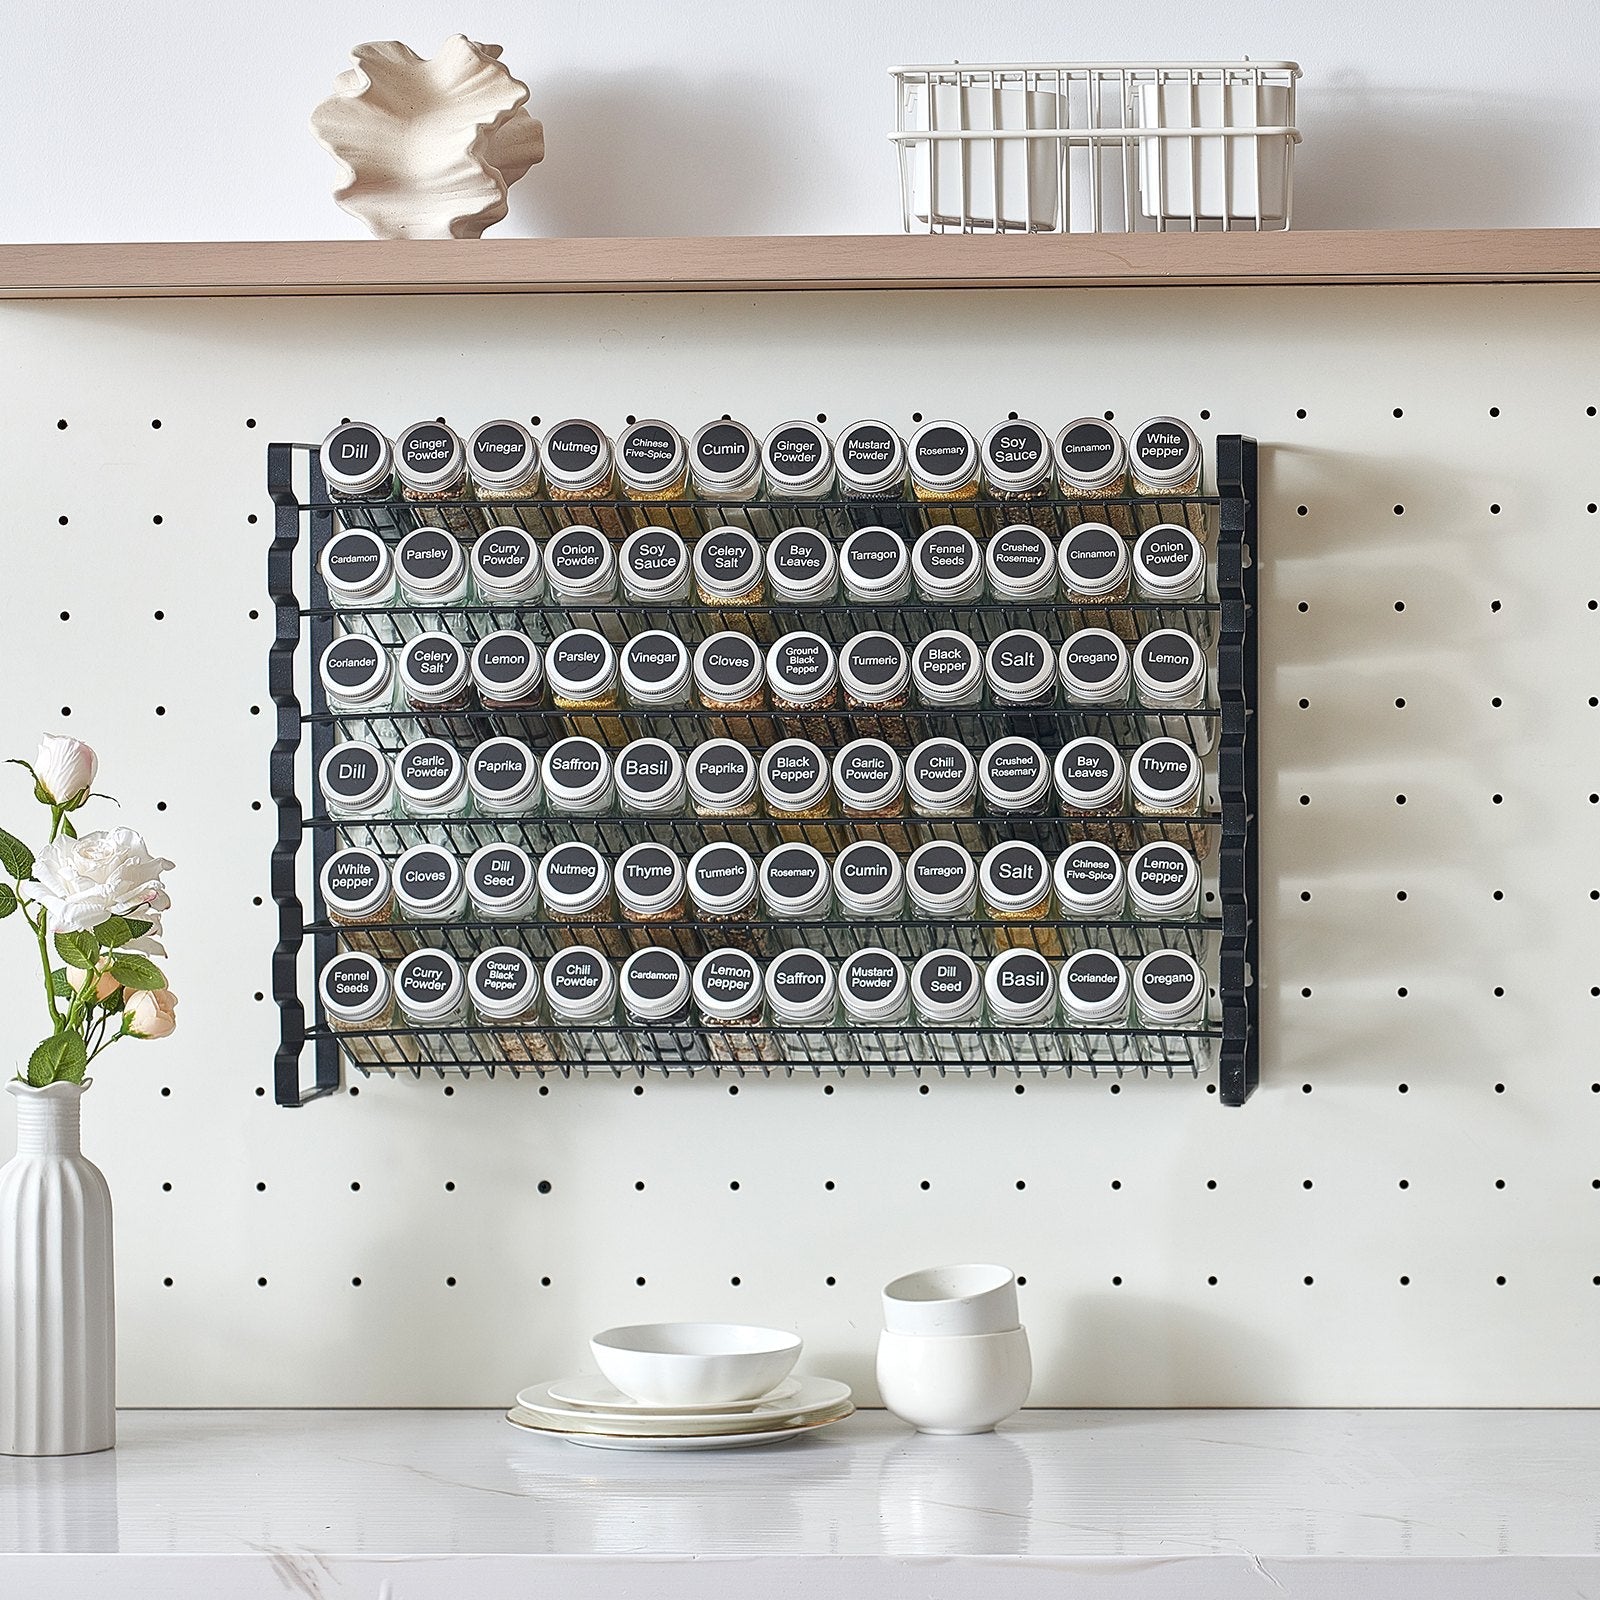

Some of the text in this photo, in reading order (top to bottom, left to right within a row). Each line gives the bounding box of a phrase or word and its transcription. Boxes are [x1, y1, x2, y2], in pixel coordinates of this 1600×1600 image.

[409, 439, 448, 451] Ginger
[632, 437, 669, 449] Chinese
[848, 439, 891, 450] Mustard
[1000, 436, 1027, 450] Soy
[1146, 433, 1181, 445] White
[341, 443, 369, 459] Dill
[477, 441, 524, 455] Vinegar
[552, 440, 599, 456] Nutmeg
[702, 442, 745, 456] Cumin
[776, 440, 815, 453] Ginger
[919, 446, 965, 456] Rosemary
[1065, 443, 1111, 454] Cinnamon
[1141, 447, 1184, 459] pepper
[407, 449, 450, 462] Powder
[625, 448, 673, 460] Five-Spice
[773, 451, 817, 463] Powder
[848, 450, 889, 461] Powder
[995, 450, 1038, 463] Sauce
[489, 543, 521, 556] Curry
[561, 544, 595, 556] Onion
[639, 544, 666, 557] Soy
[707, 545, 747, 559] Celery
[789, 544, 813, 558] Bay
[929, 543, 965, 554] Fennel
[1001, 542, 1040, 553] Crushed
[1150, 541, 1184, 553] Onion
[330, 554, 378, 564] Cardamom
[406, 547, 449, 561] Parsley
[482, 554, 526, 566] Powder
[556, 554, 600, 567] Powder
[850, 550, 897, 562] Tarragon
[931, 555, 965, 566] Seeds
[995, 553, 1043, 565] Rosemary
[1070, 550, 1116, 560] Cinnamon
[1145, 552, 1189, 565] Powder
[634, 557, 677, 570] Sauce
[714, 557, 739, 569] Salt
[779, 556, 821, 569] Leaves
[414, 650, 453, 664] Celery
[558, 650, 601, 664] Parsley
[785, 645, 819, 656] Ground
[928, 648, 962, 660] Black
[328, 657, 376, 669] Coriander
[484, 653, 525, 665] Lemon
[630, 651, 678, 665] Vinegar
[708, 654, 750, 668] Cloves
[789, 655, 815, 665] Black
[851, 655, 898, 666] Turmeric
[1000, 651, 1035, 667] Salt
[1068, 652, 1118, 665] Oregano
[1148, 651, 1190, 665] Lemon
[420, 662, 444, 674] Salt
[785, 665, 819, 676] Pepper
[923, 661, 967, 674] Pepper
[412, 755, 445, 767] Garlic
[477, 759, 523, 774] Paprika
[551, 757, 600, 771] Saffron
[776, 756, 810, 769] Black
[851, 757, 885, 769] Garlic
[929, 756, 954, 768] Chili
[995, 755, 1034, 766] Crushed
[1077, 755, 1100, 769] Bay
[1141, 757, 1188, 774] Thyme
[338, 763, 366, 779] Dill
[406, 766, 450, 778] Powder
[625, 760, 668, 776] Basil
[699, 762, 745, 776] Paprika
[845, 768, 889, 780] Powder
[920, 768, 964, 780] Powder
[991, 768, 1038, 778] Rosemary
[1067, 767, 1109, 778] Leaves
[771, 769, 816, 782] Pepper
[337, 863, 372, 875] White
[491, 859, 511, 872] Dill
[549, 862, 596, 878] Nutmeg
[844, 863, 888, 877] Cumin
[1072, 859, 1110, 870] Chinese
[1143, 857, 1185, 871] Lemon
[405, 870, 446, 883] Cloves
[626, 864, 673, 879] Thyme
[697, 863, 745, 879] Turmeric
[770, 868, 817, 878] Rosemary
[917, 865, 964, 878] Tarragon
[998, 863, 1034, 880] Salt
[1066, 869, 1114, 882] Five-Spice
[1140, 871, 1184, 884] pepper
[331, 877, 375, 890] pepper
[483, 874, 515, 887] Seed
[486, 960, 521, 972] Ground
[565, 964, 591, 976] Chili
[709, 963, 752, 978] Lemon
[851, 966, 894, 977] Mustard
[937, 965, 957, 977] Dill
[334, 970, 370, 982] Fennel
[411, 966, 444, 980] Curry
[488, 969, 515, 981] Black
[630, 969, 678, 981] Cardamom
[776, 971, 824, 985] Saffron
[1001, 970, 1045, 987] Basil
[1069, 972, 1119, 983] Coriander
[1144, 973, 1194, 986] Oregano
[403, 976, 447, 992] Powder
[483, 978, 518, 991] Pepper
[555, 975, 599, 987] Powder
[706, 976, 751, 992] pepper
[851, 977, 893, 988] Powder
[930, 980, 962, 992] Seed
[335, 982, 369, 994] Seeds
